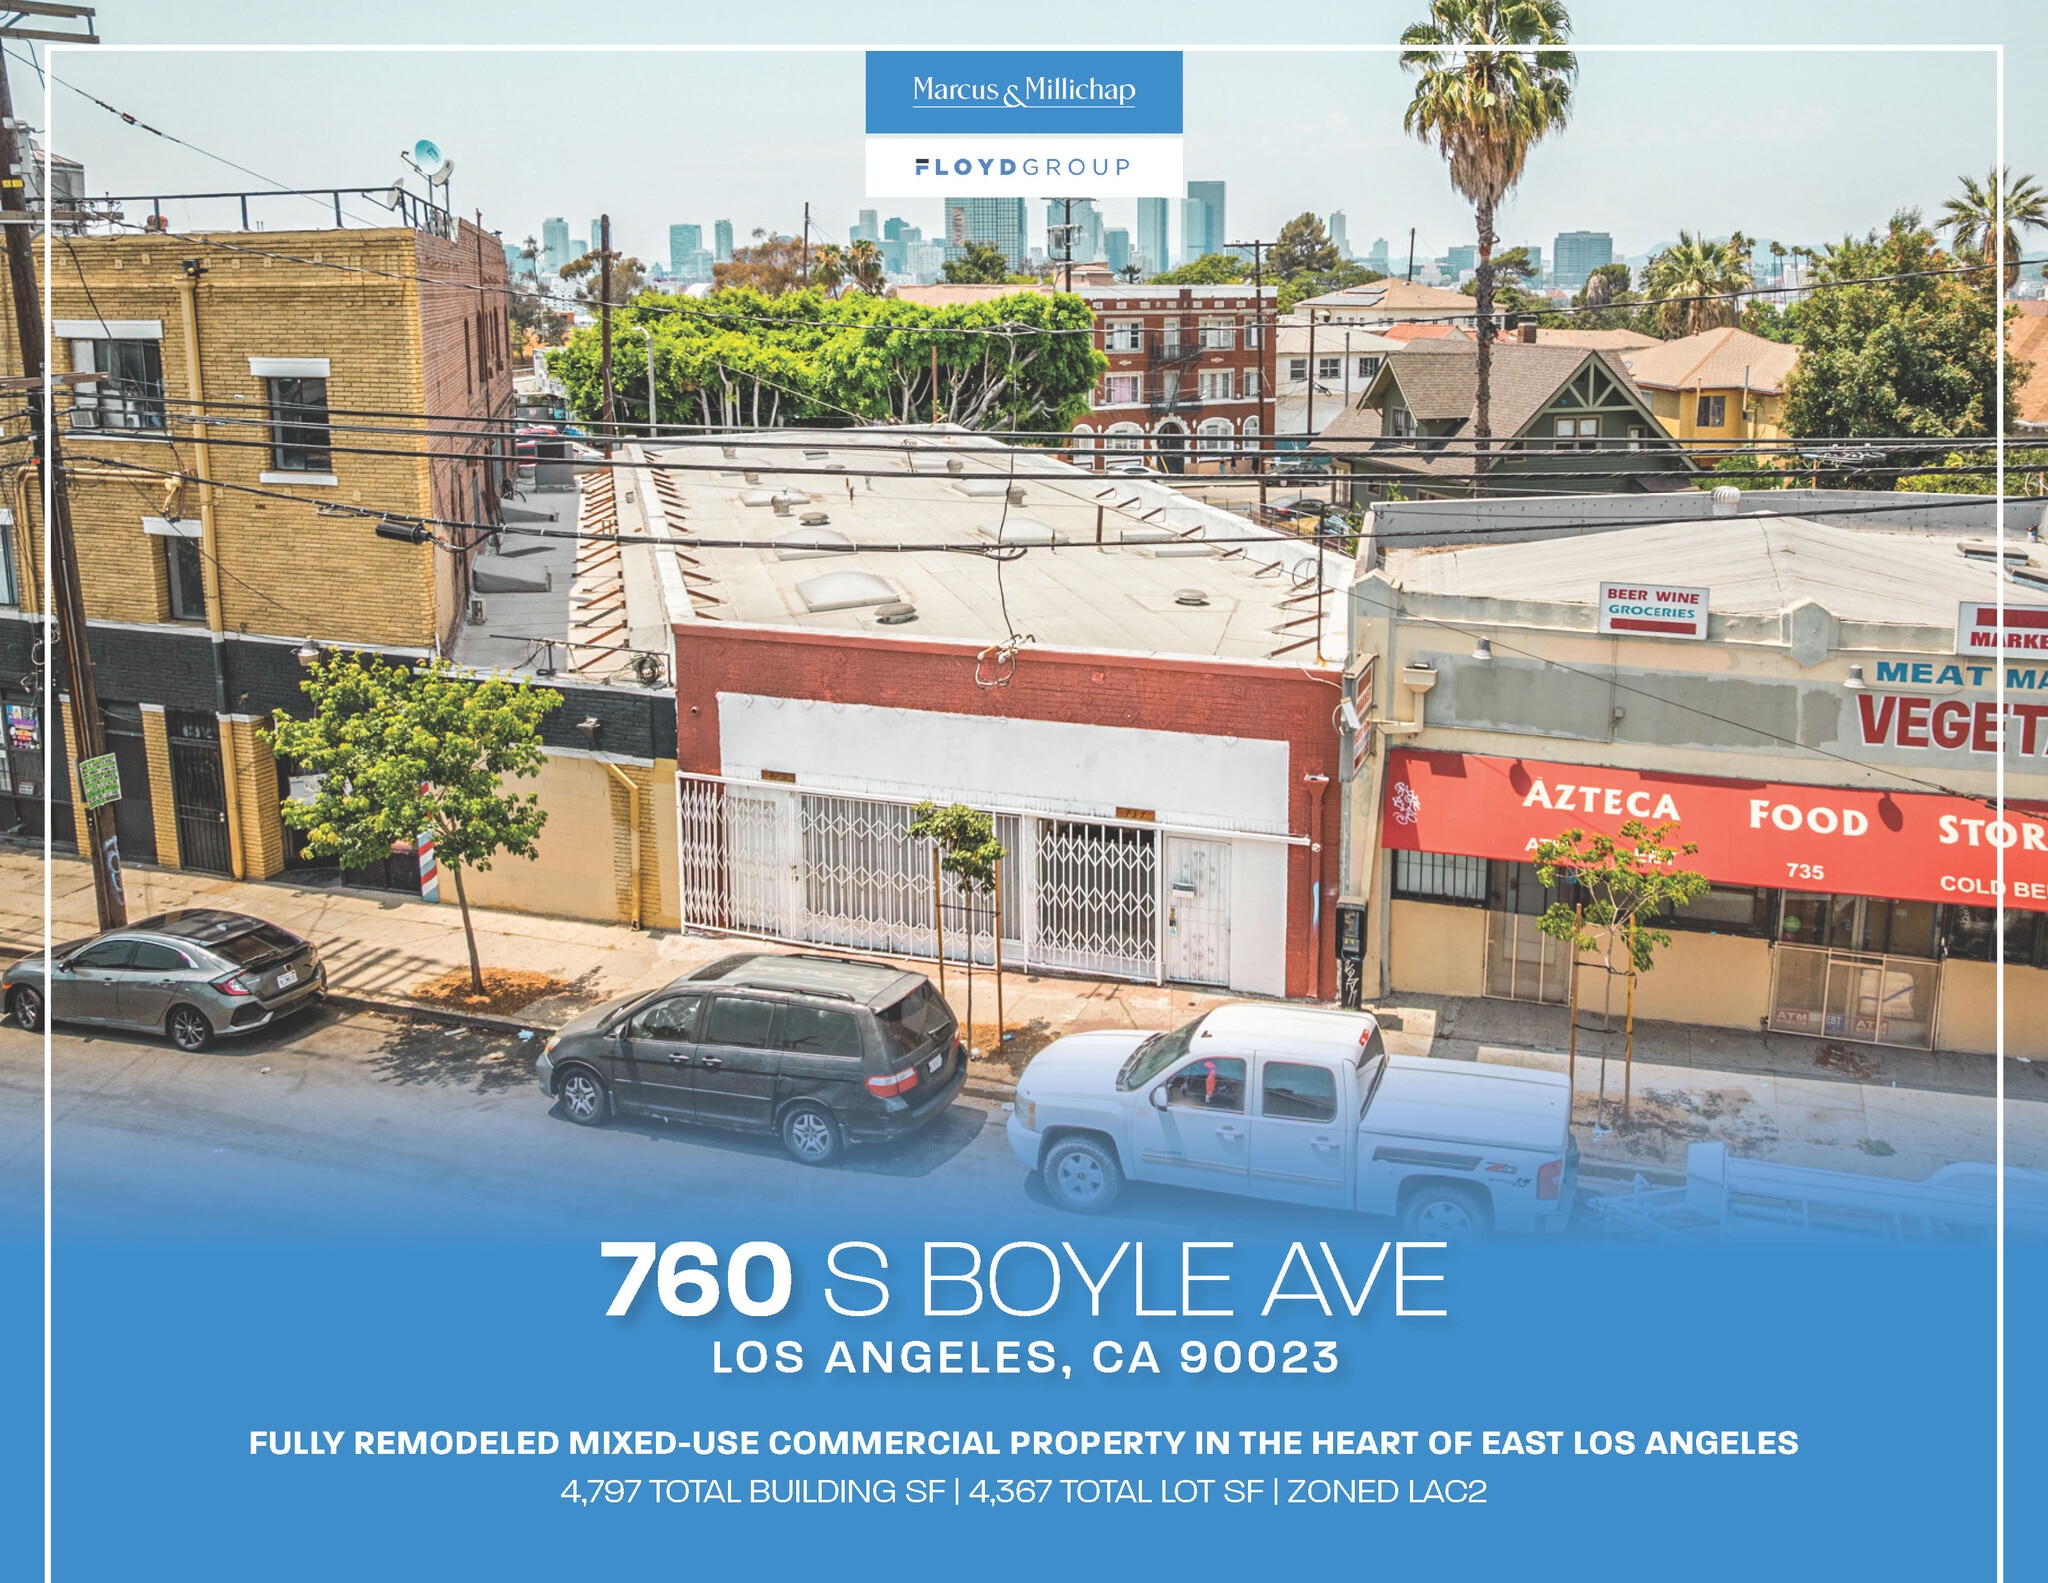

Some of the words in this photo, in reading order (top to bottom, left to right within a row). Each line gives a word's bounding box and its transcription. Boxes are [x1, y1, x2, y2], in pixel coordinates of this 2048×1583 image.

[1607, 588, 1648, 601] BEER
[1655, 591, 1700, 604] WINE
[1608, 604, 1695, 618] GROCERIES
[1876, 661, 1993, 686] MEAT
[1856, 693, 2048, 757] VEGET
[1522, 778, 1682, 821] AZTECA
[1749, 799, 1869, 837] FOOD
[1786, 862, 1825, 880] 735
[2013, 881, 2048, 900] BE
[1776, 1011, 1807, 1022] ATM
[1825, 1015, 1842, 1025] EBT
